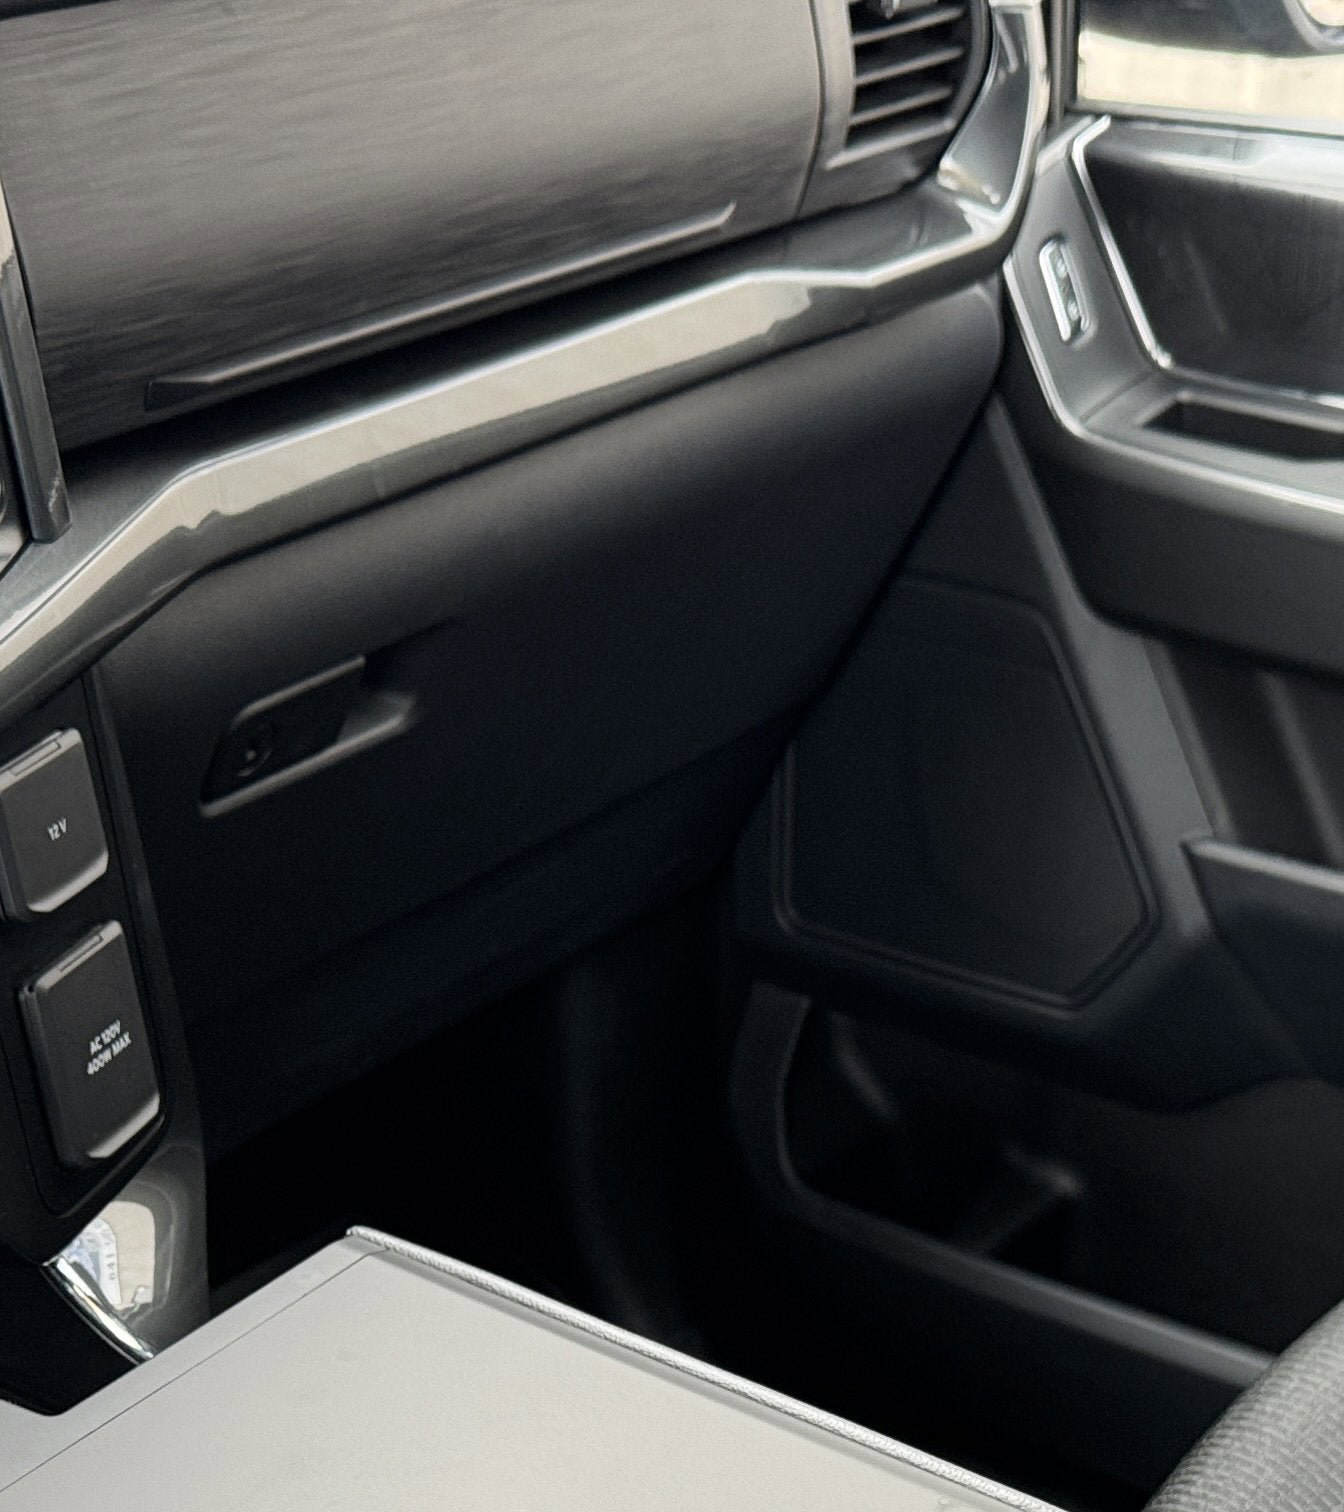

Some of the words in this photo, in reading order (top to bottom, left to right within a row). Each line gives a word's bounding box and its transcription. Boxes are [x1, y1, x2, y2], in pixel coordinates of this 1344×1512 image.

[86, 1048, 113, 1075] 400W
[111, 1031, 132, 1057] MAX
[89, 1035, 103, 1056] AC
[100, 1019, 121, 1045] 120V
